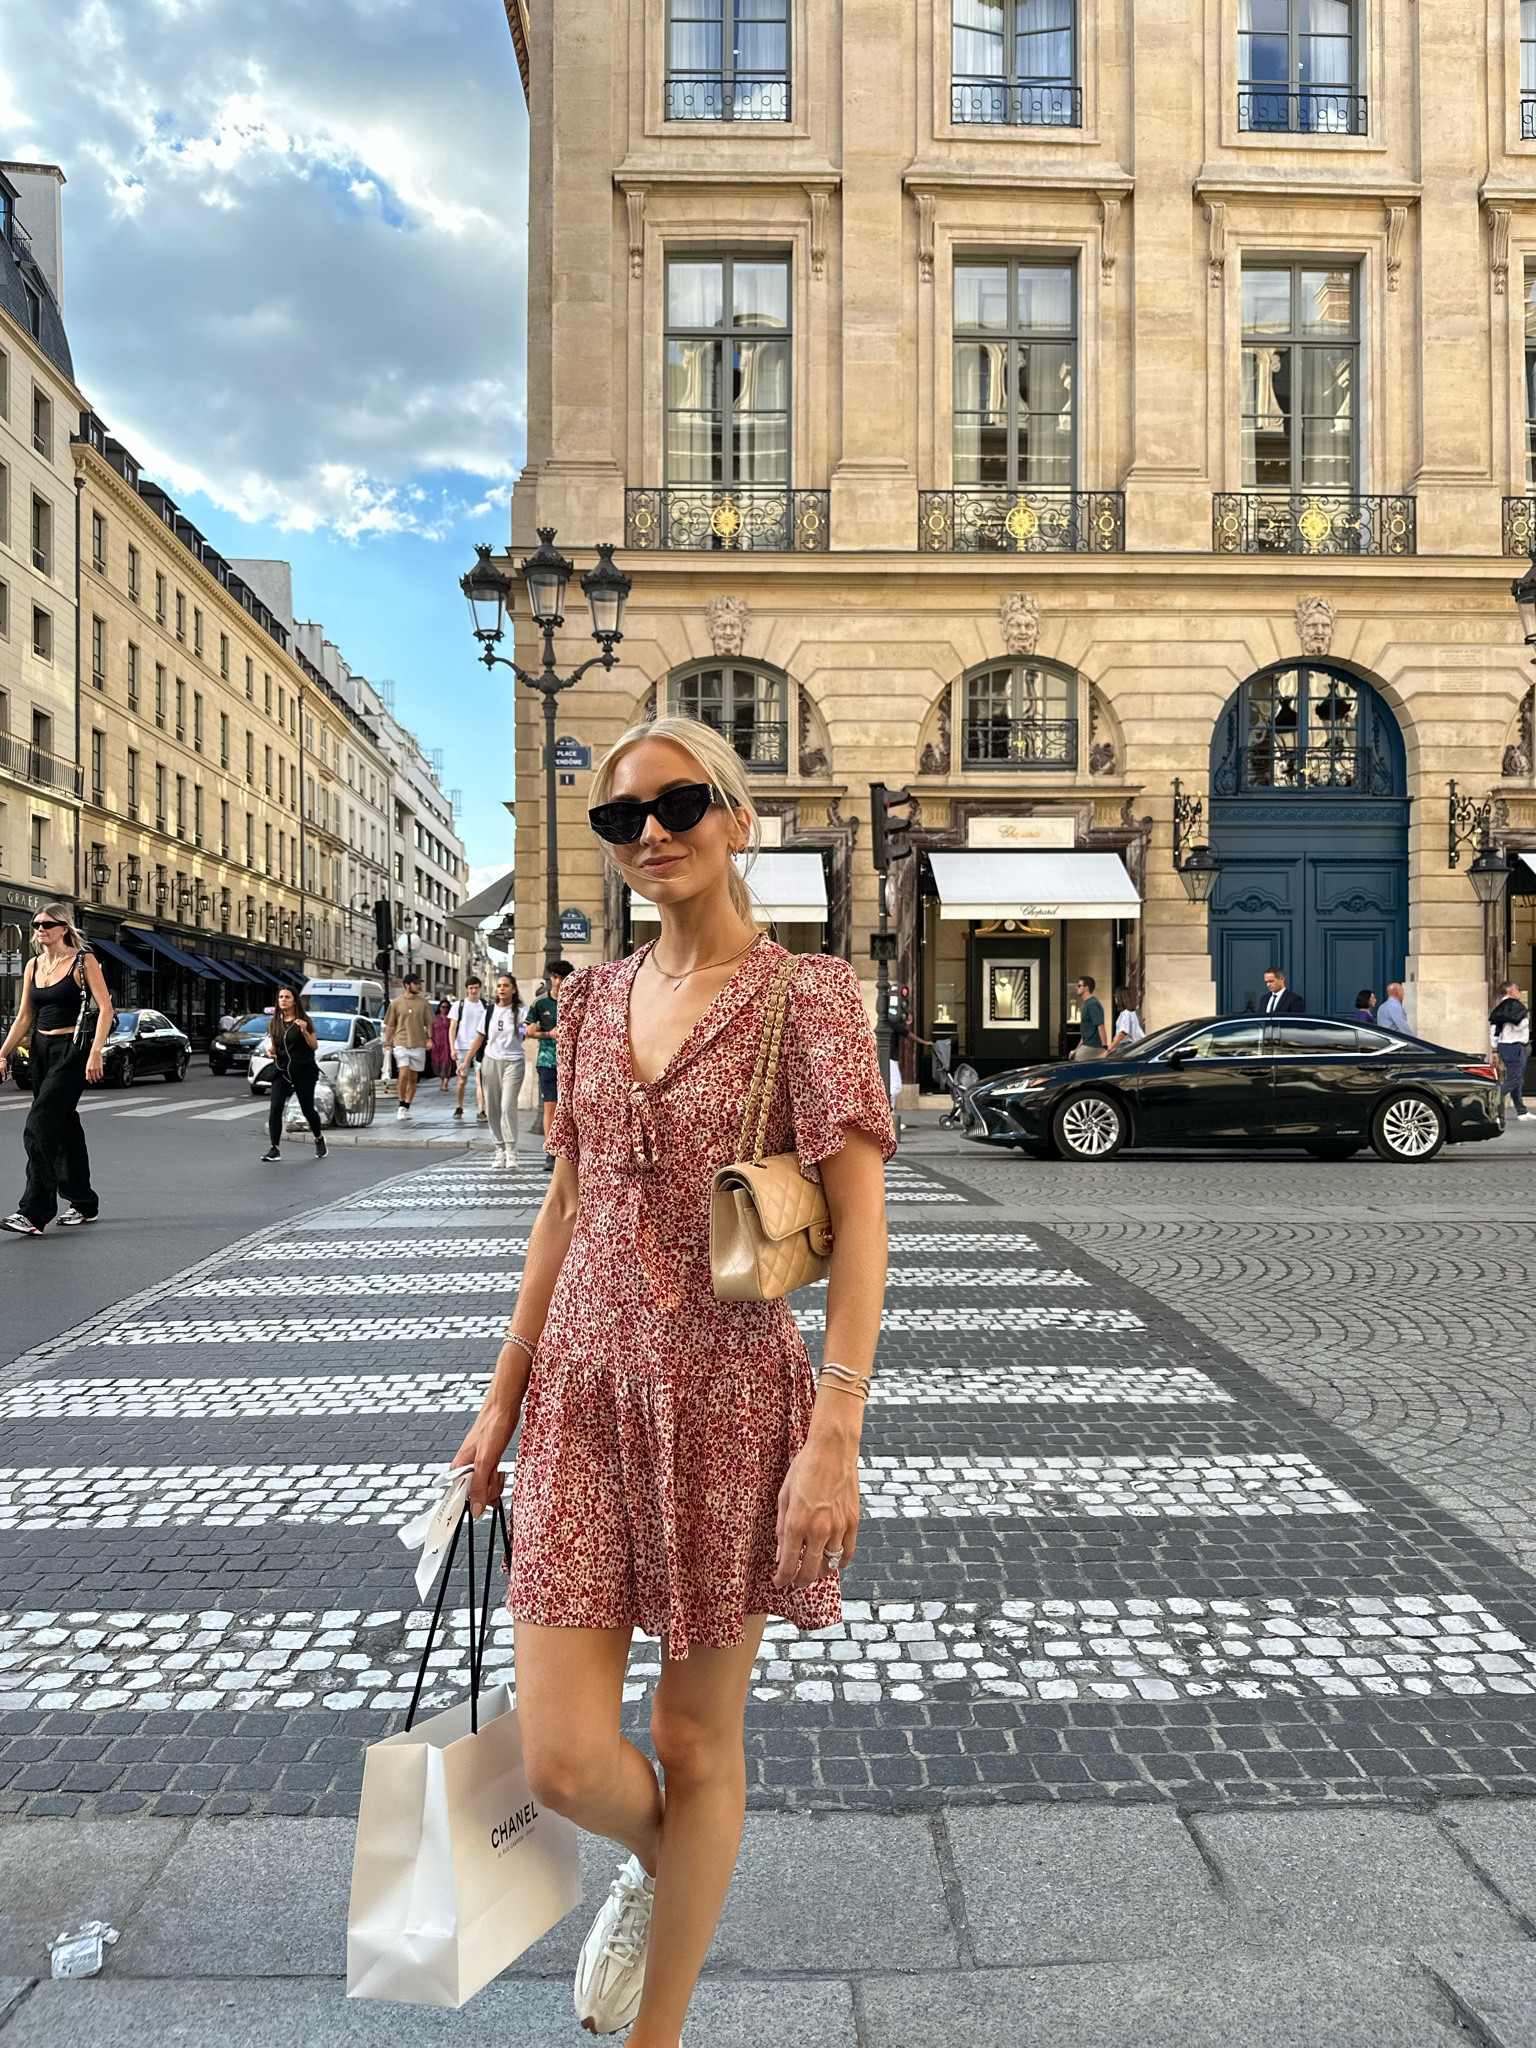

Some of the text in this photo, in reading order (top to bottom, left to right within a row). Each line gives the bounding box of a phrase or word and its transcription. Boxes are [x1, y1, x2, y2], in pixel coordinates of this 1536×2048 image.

[7, 891, 39, 908] GRAFF
[1020, 904, 1060, 917] Chopard
[497, 1020, 504, 1032] 9
[491, 1801, 538, 1849] CHANEL
